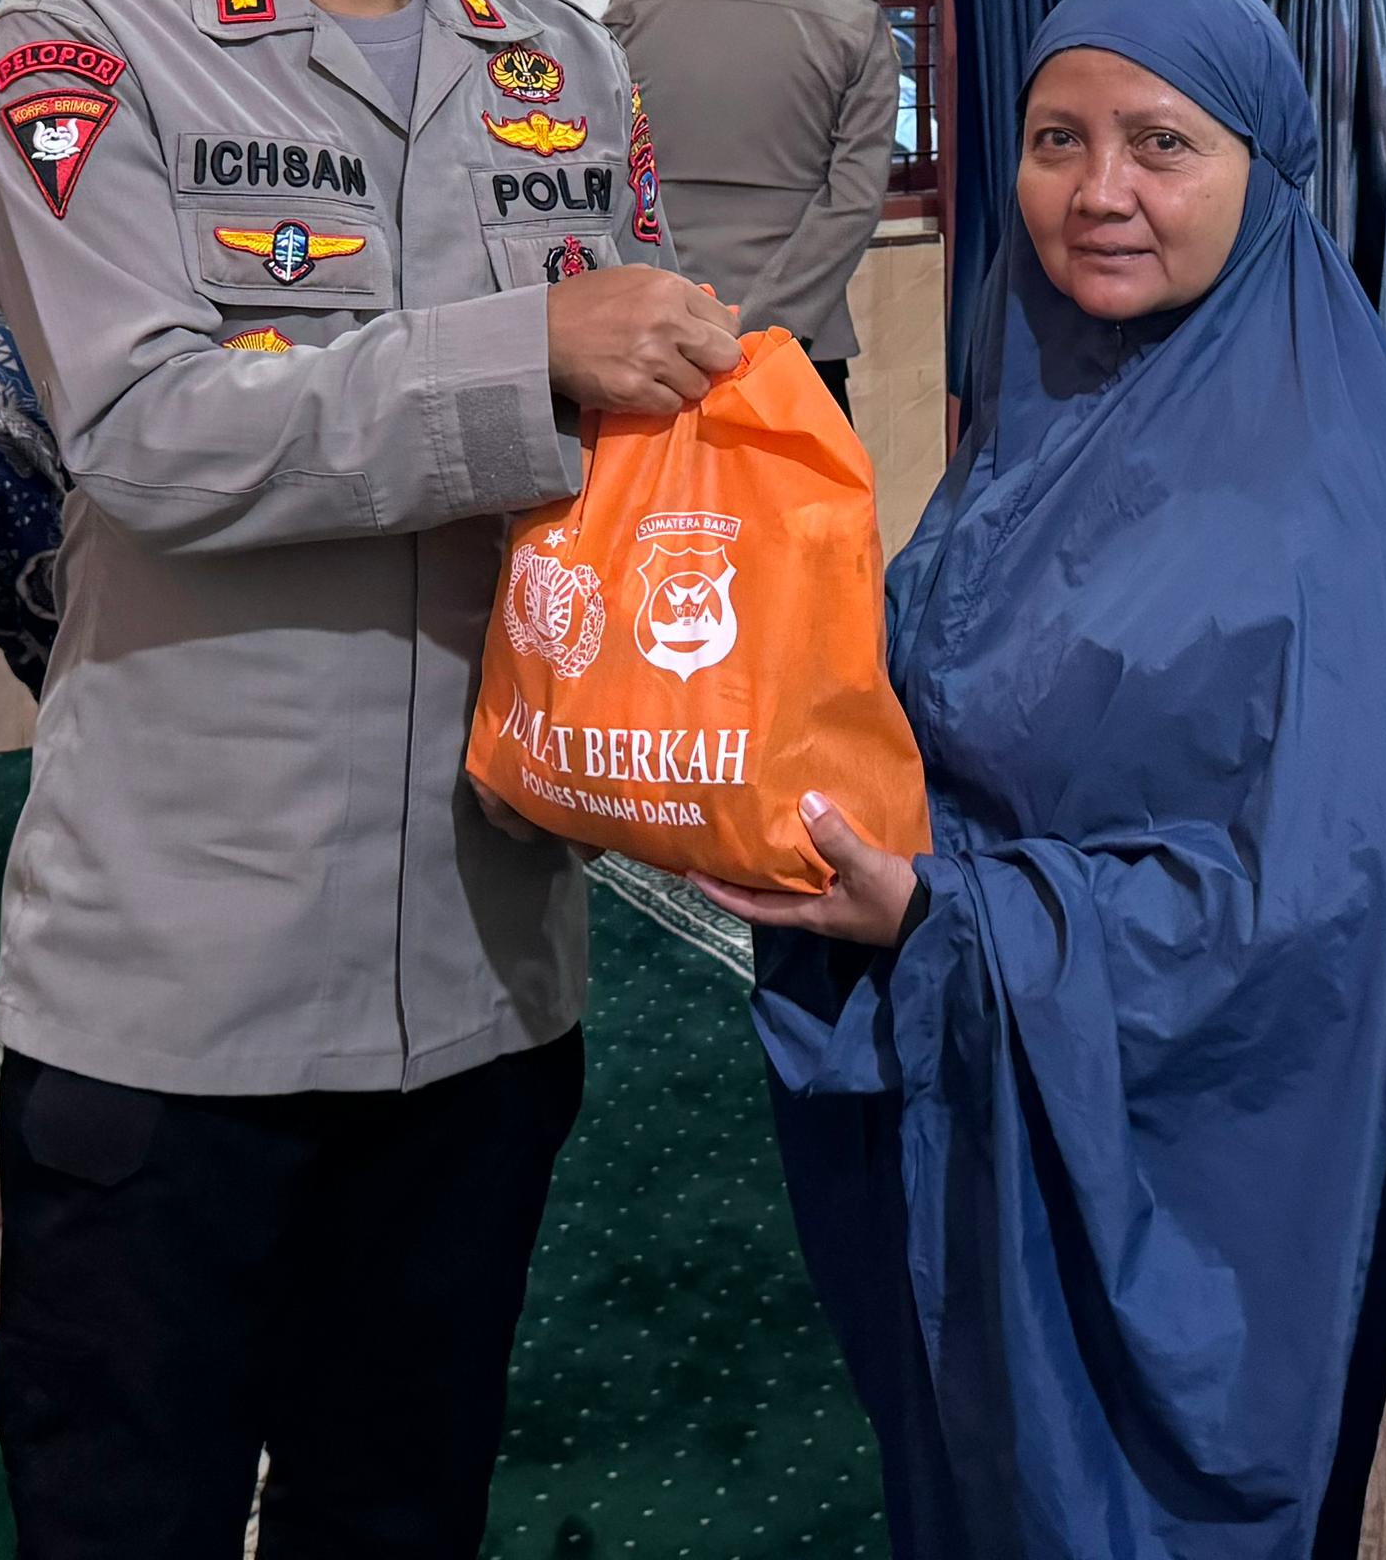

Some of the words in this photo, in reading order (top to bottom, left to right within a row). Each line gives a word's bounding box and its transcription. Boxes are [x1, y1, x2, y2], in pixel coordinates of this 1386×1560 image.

[0, 45, 115, 80] PELOPOR
[13, 102, 49, 123] KORPS
[54, 100, 101, 115] BRIMOB
[194, 138, 367, 198] ICHSAN
[492, 168, 613, 218] POLRI
[639, 517, 700, 536] SUMATERA
[703, 517, 737, 535] BARAT
[582, 727, 751, 786] BERKAH
[521, 766, 576, 810] POLRES
[576, 790, 640, 824] TANAH
[641, 799, 707, 828] DATAR
